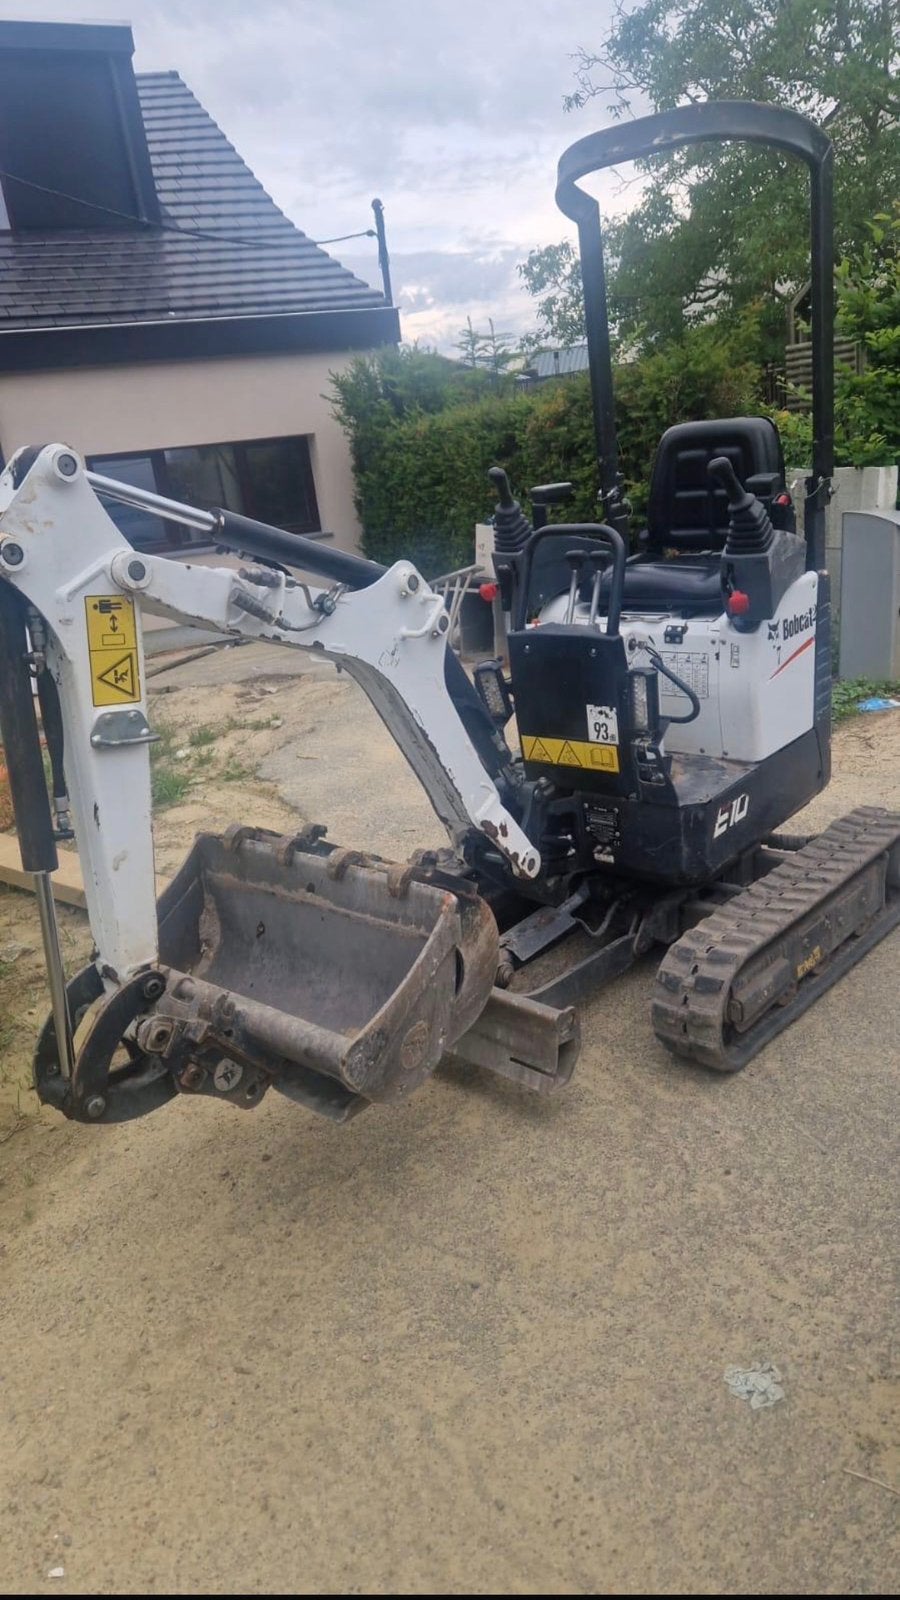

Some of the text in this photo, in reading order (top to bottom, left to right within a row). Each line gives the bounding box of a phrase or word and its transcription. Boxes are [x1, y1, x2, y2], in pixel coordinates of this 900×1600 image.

[783, 607, 813, 640] Bobcat
[593, 721, 609, 740] 93
[713, 793, 749, 839] E10
